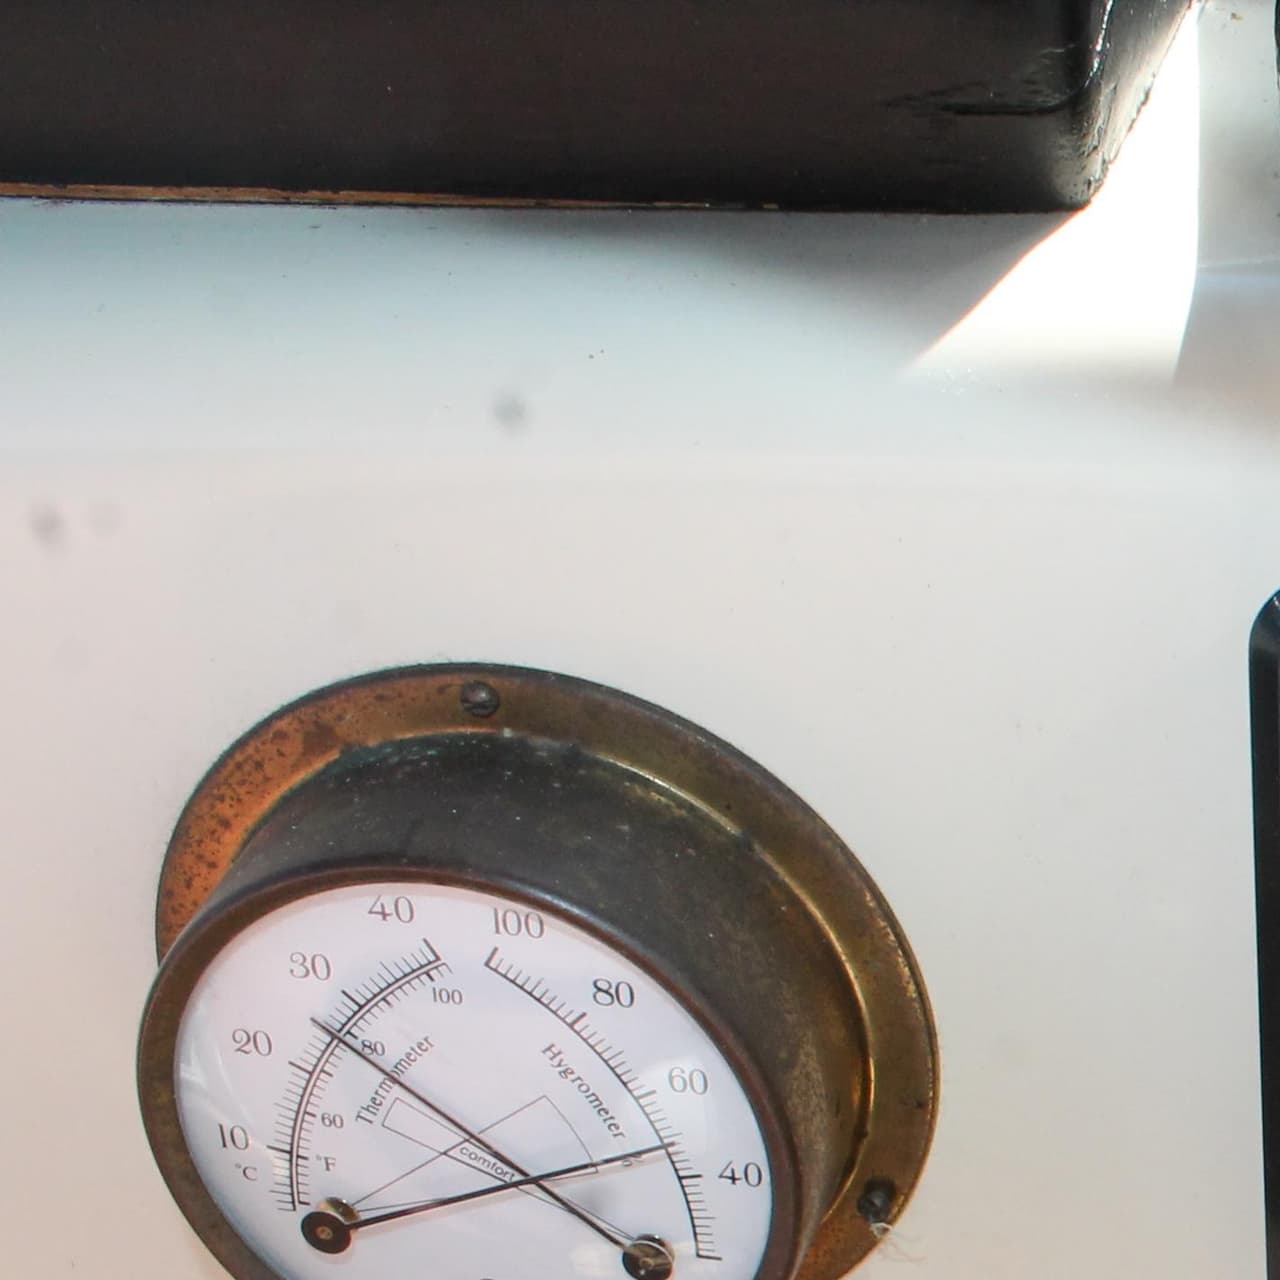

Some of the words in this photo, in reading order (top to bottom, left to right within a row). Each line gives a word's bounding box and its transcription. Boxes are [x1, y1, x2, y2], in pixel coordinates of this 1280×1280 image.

[367, 894, 415, 924] 40
[493, 907, 546, 939] 100
[288, 951, 332, 981] 30
[432, 986, 463, 1005] 100
[591, 978, 635, 1008] 80
[231, 1028, 273, 1057] 20
[360, 1038, 386, 1057] 80
[355, 1035, 436, 1125] Thermometer
[541, 1043, 626, 1139] Hygrometer
[667, 1066, 709, 1095] 60
[321, 1112, 344, 1129] 60
[218, 1123, 249, 1150] 10
[459, 1146, 516, 1182] comfort
[717, 1160, 763, 1188] 40
